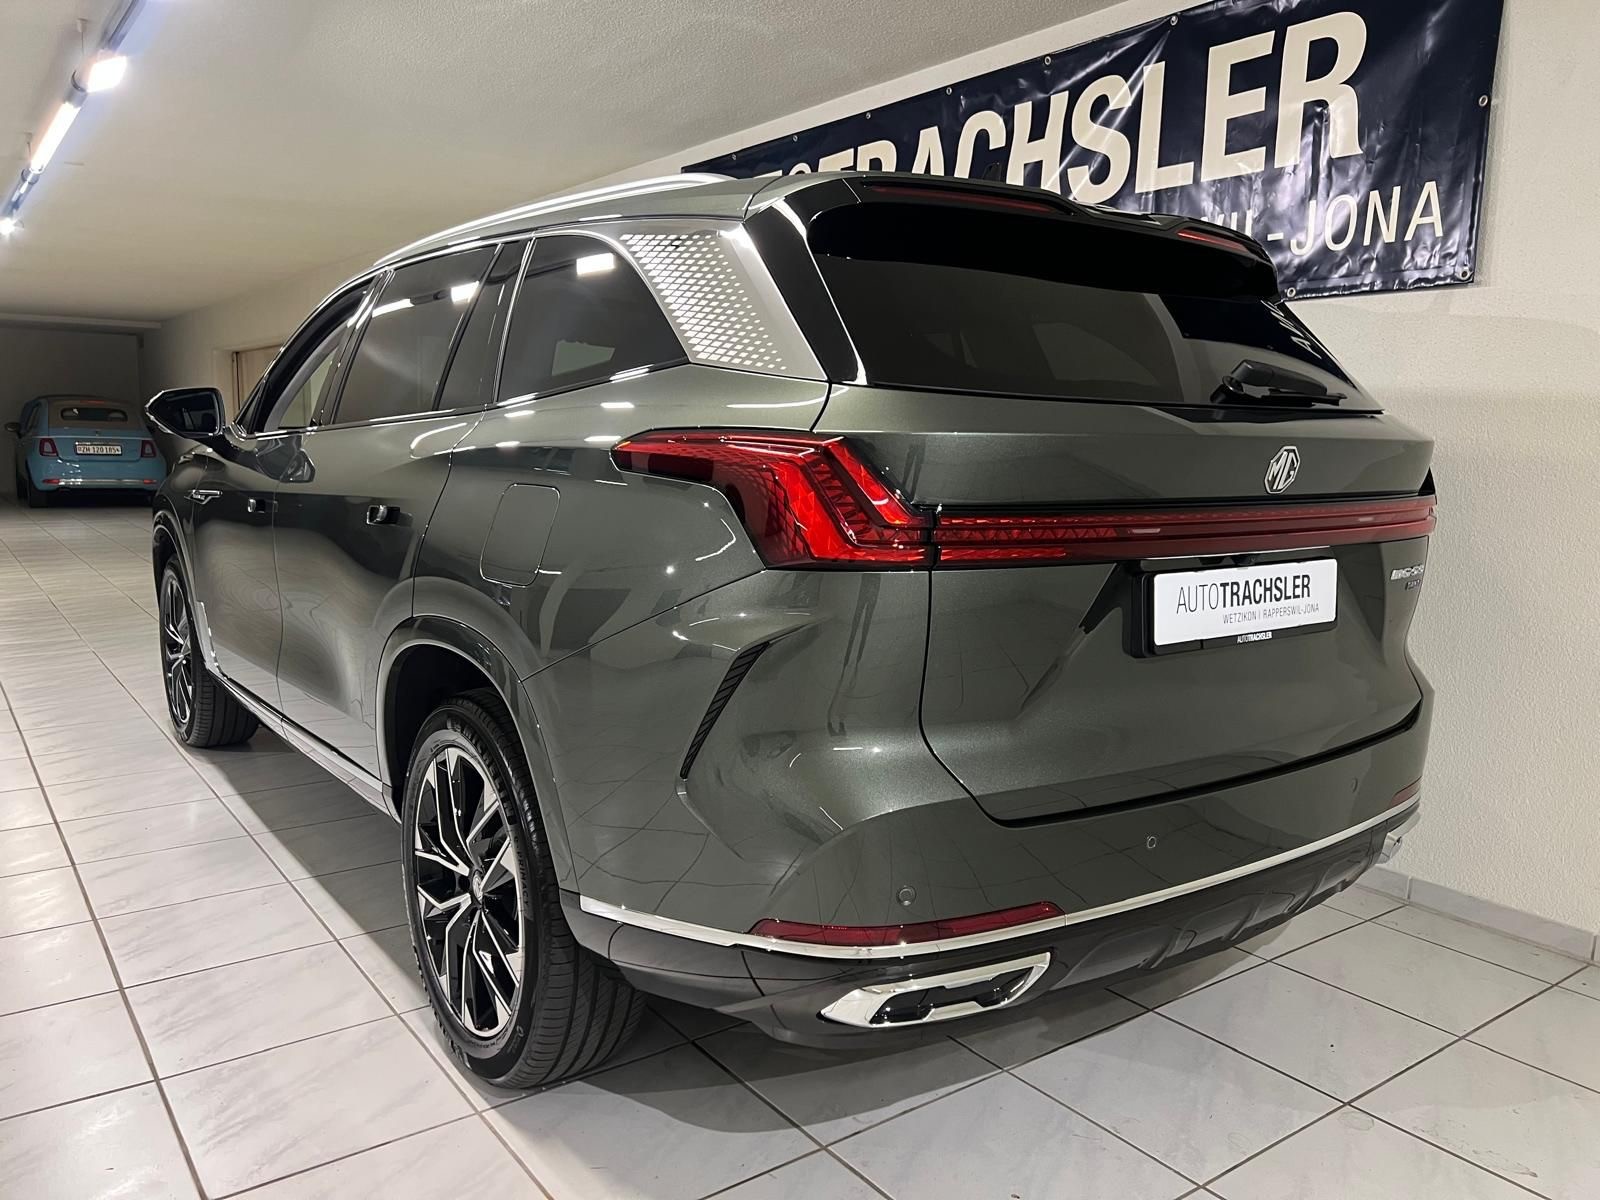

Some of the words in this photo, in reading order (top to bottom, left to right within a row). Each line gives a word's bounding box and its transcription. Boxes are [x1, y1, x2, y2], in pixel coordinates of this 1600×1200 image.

[1268, 450, 1298, 490] MG
[1176, 574, 1311, 614] AUTOTRACHSLER
[1222, 611, 1257, 625] WETZIKON
[1262, 603, 1320, 619] RAPPERSWIL-JONA
